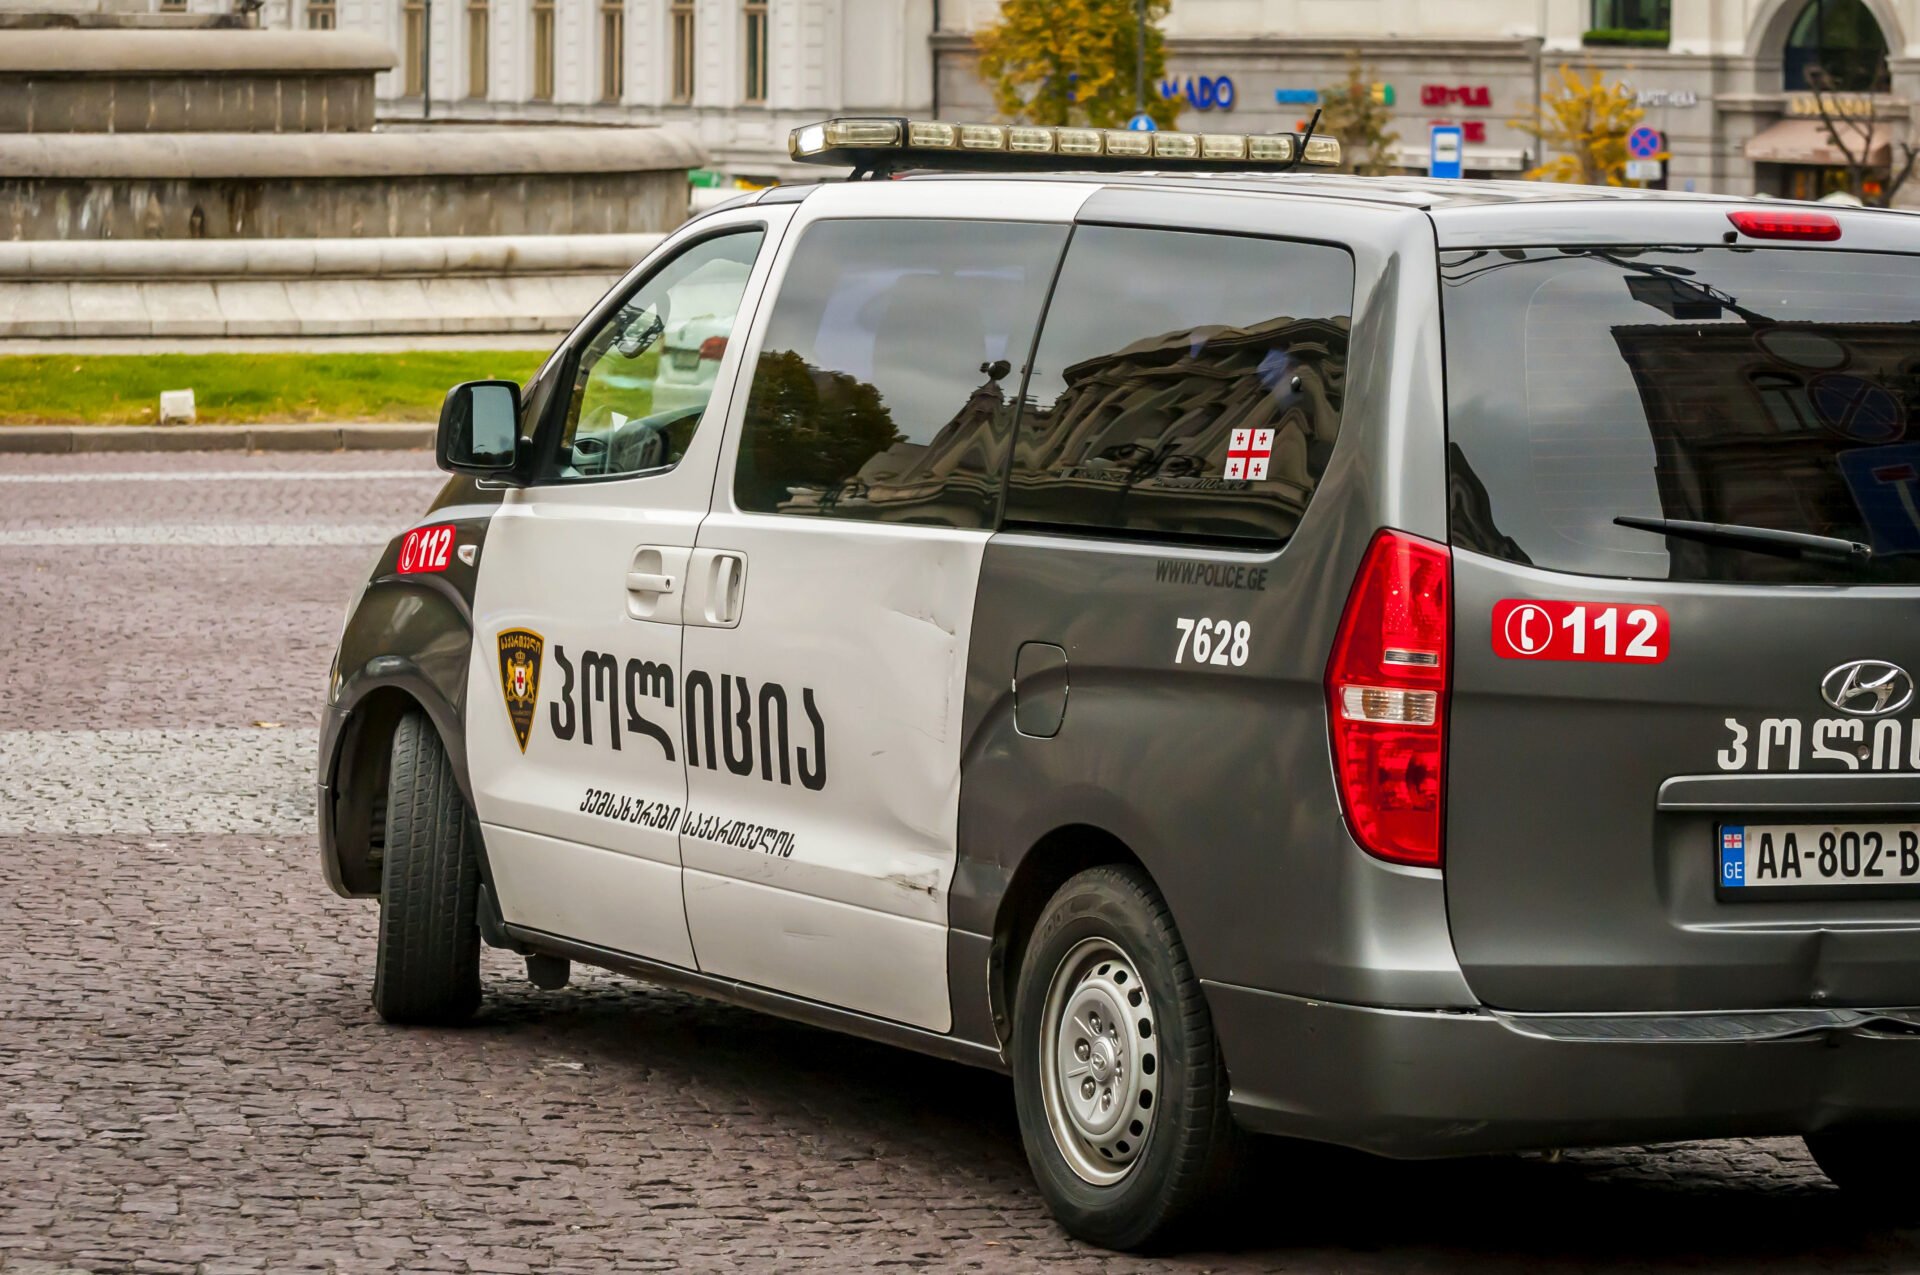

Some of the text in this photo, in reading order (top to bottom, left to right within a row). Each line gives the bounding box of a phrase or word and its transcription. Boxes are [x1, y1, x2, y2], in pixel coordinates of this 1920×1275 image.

[418, 528, 452, 568] 112
[1156, 560, 1269, 591] WWW.POLICE.GE
[1174, 617, 1251, 667] 7628
[1562, 606, 1658, 658] 112
[549, 645, 827, 792] პოლიცია
[681, 811, 796, 858] საქართველოს
[1757, 831, 1920, 879] AA-802-B
[1724, 861, 1743, 879] GE
